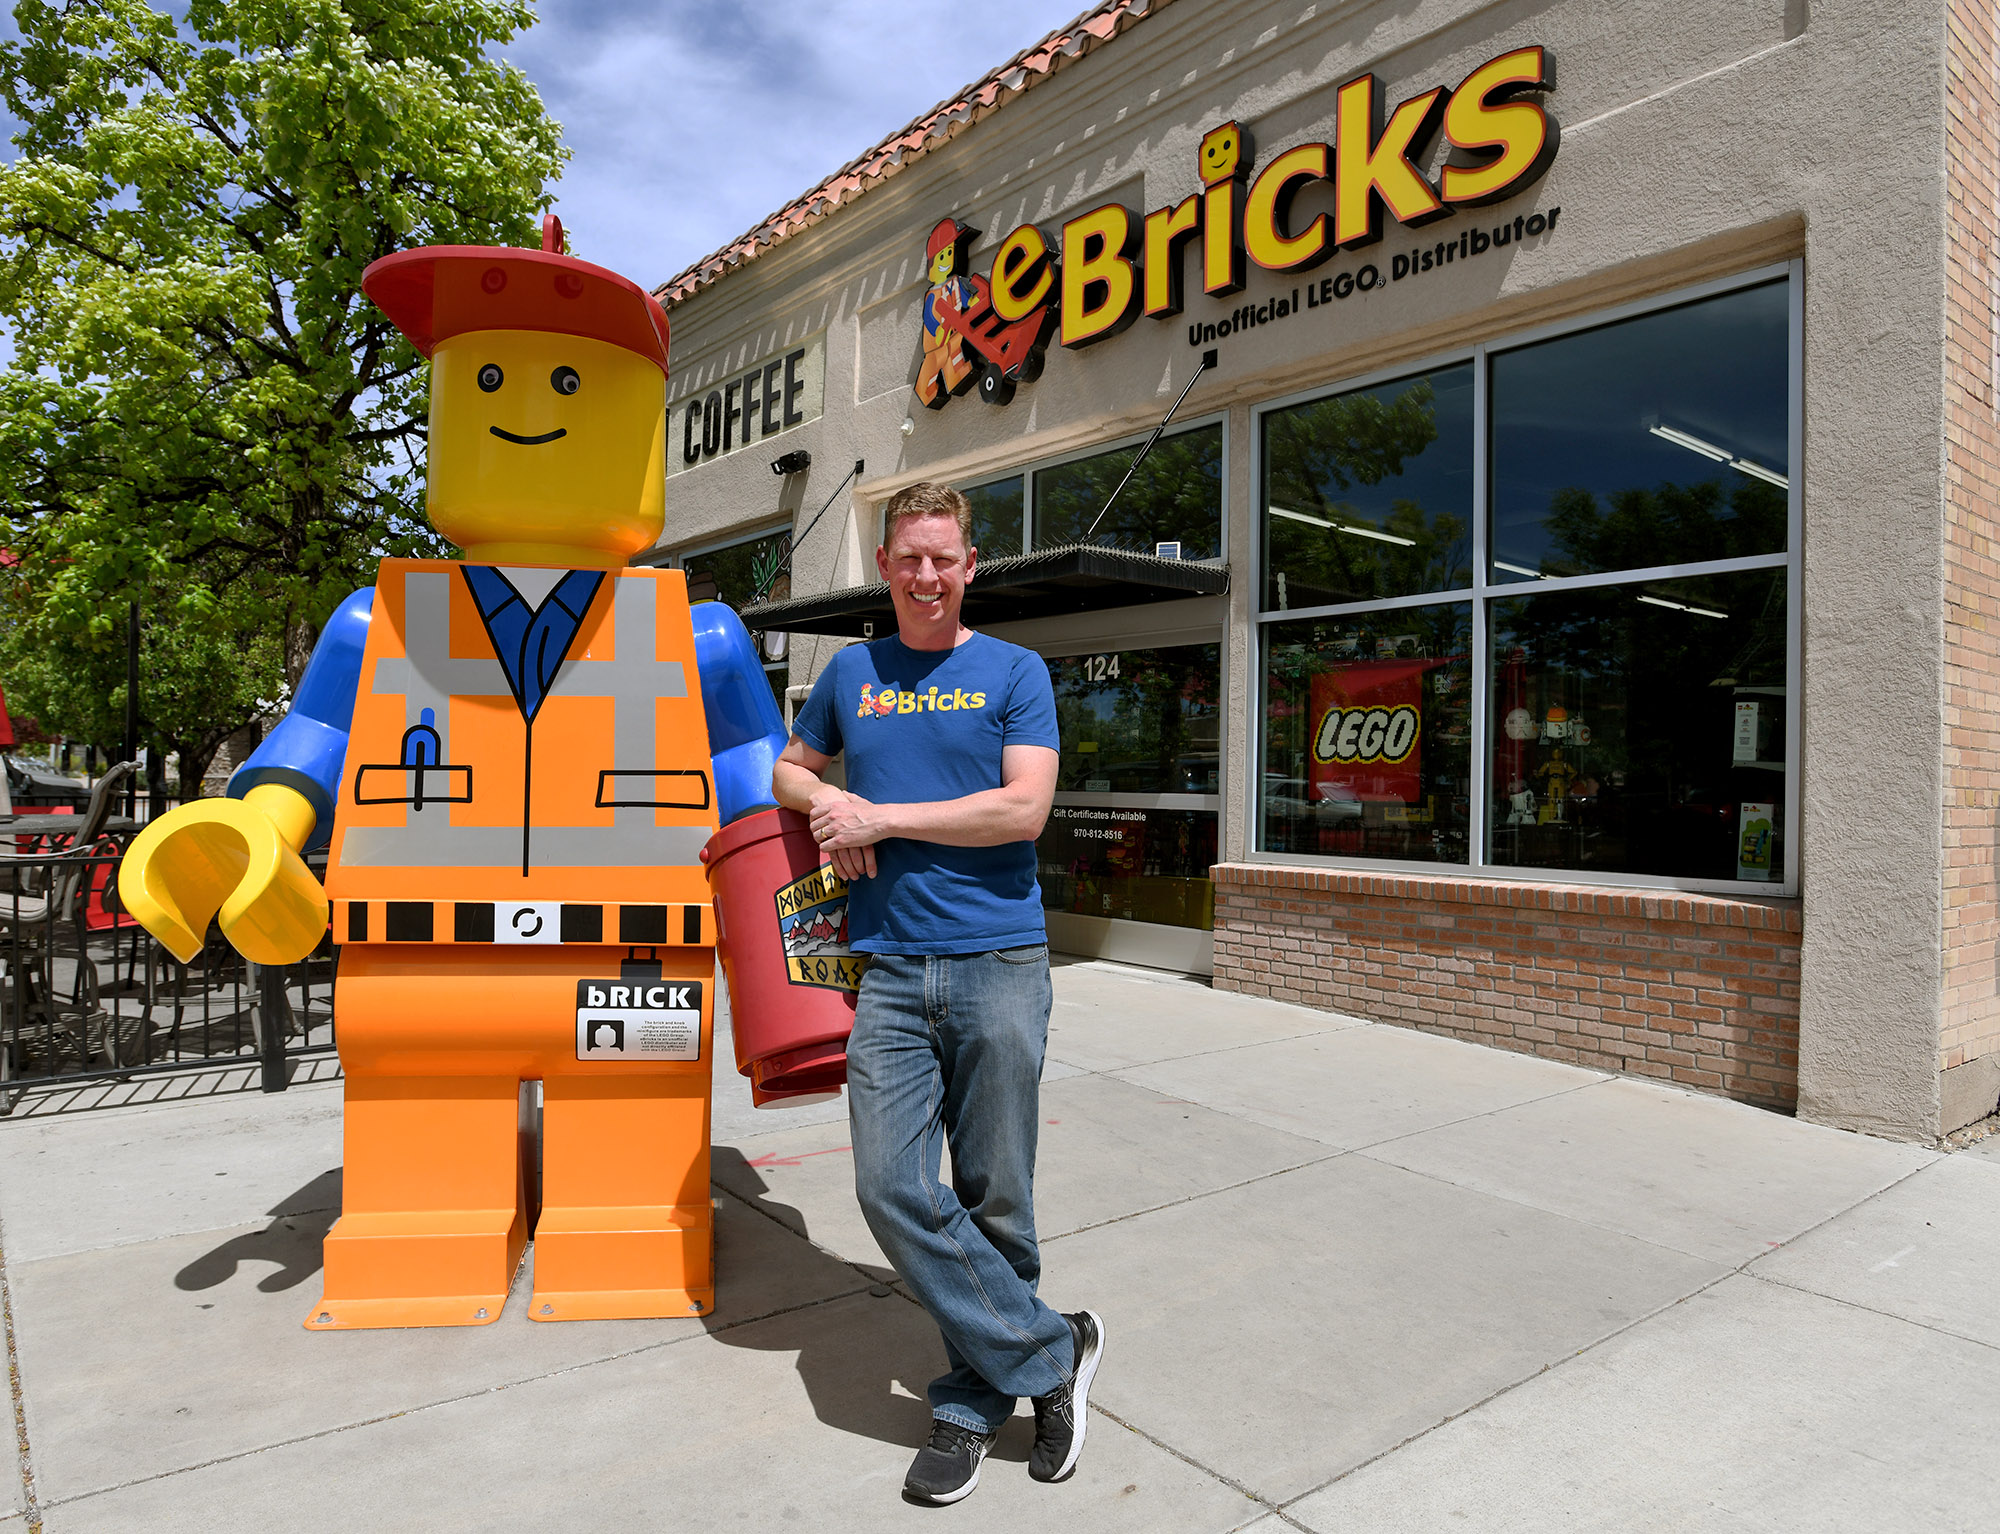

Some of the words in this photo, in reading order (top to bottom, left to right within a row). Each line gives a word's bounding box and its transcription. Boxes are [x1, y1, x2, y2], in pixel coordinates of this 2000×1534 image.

[990, 45, 1560, 348] eBricks
[1188, 289, 1299, 347] Unofficial
[1392, 207, 1562, 282] Distributor
[683, 348, 806, 464] COFFEE
[1084, 655, 1121, 682] 124
[878, 686, 987, 714] eBricks
[1316, 707, 1418, 760] LEGO
[1053, 809, 1067, 818] Gift
[1067, 809, 1110, 821] Certificates
[1111, 811, 1147, 822] Available
[1073, 828, 1123, 840] 970-812-8516
[587, 986, 691, 1008] bRICK
